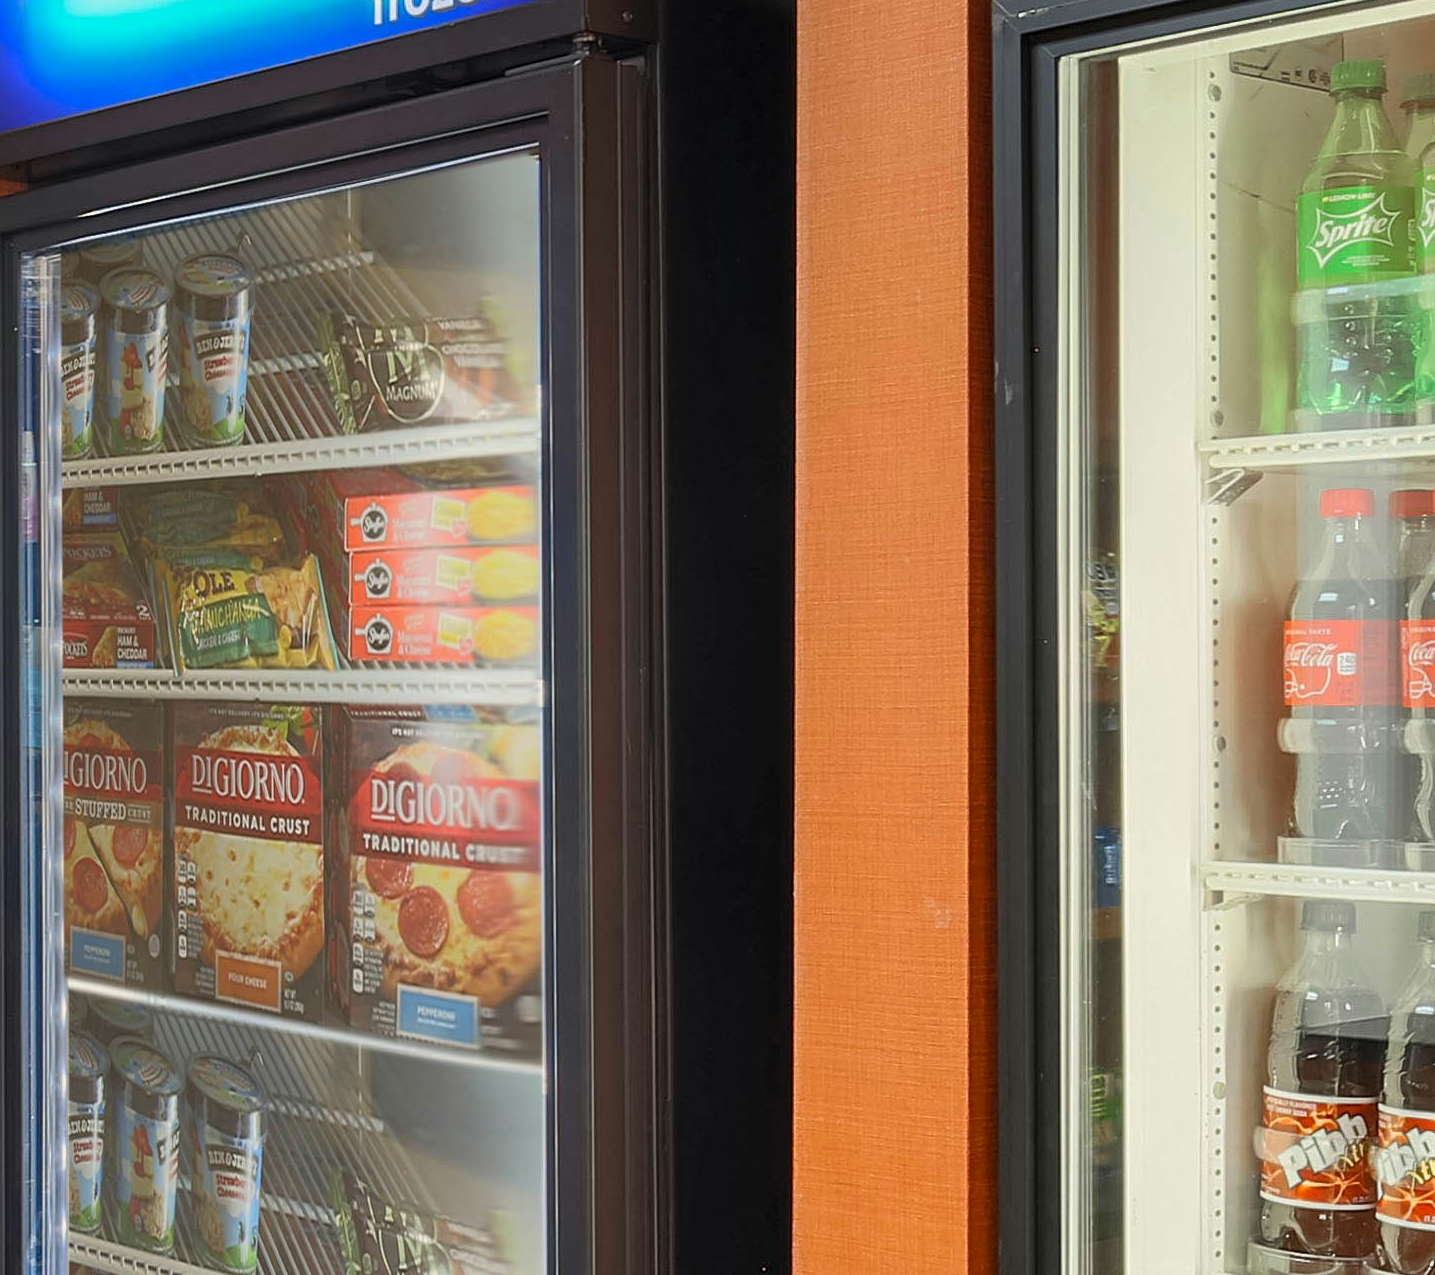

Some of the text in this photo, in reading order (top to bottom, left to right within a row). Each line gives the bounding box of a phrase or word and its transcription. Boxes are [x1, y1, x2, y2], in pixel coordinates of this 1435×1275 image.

[1313, 214, 1391, 249] Sprite
[386, 383, 436, 403] MAGNUM
[1309, 626, 1332, 636] TASTE
[117, 647, 148, 661] CHEDDAR
[1337, 654, 1357, 667] 240
[185, 804, 311, 837] TRADITIONAL CRUST
[1276, 1113, 1370, 1190] Pibb
